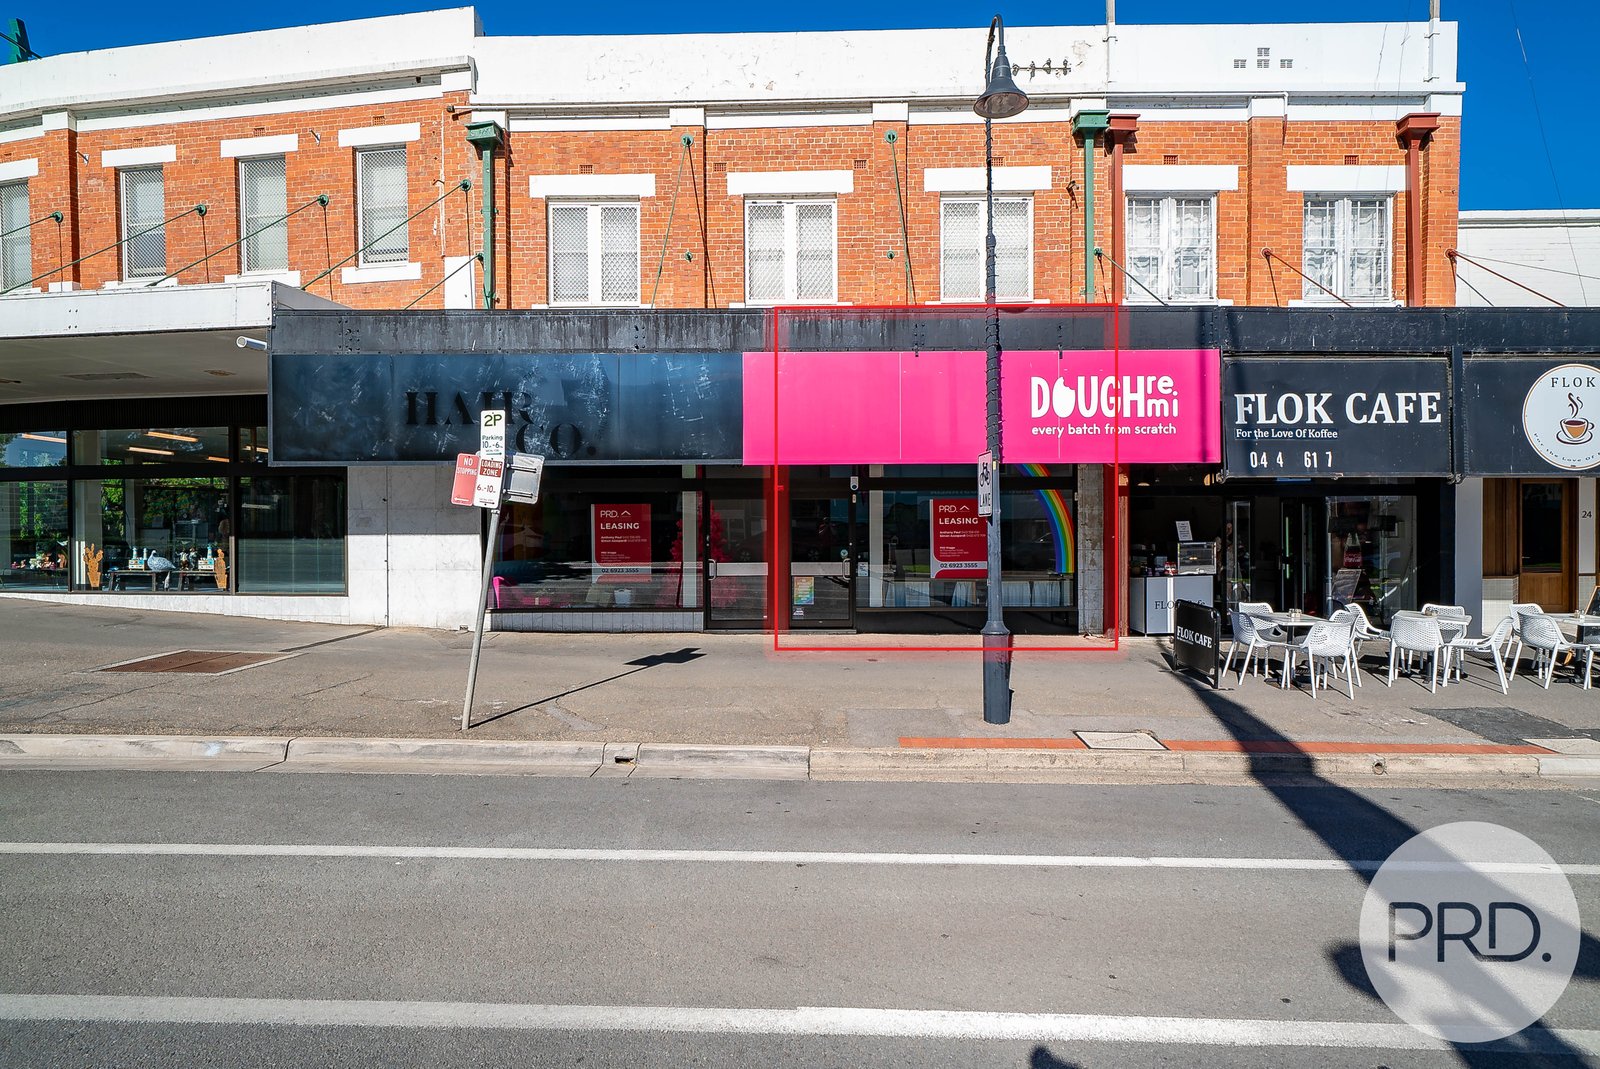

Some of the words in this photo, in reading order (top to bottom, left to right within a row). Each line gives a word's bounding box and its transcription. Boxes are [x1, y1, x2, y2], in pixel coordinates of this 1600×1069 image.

[1551, 377, 1596, 388] FLOK
[1031, 376, 1145, 418] DOUGH
[1234, 393, 1334, 424] FLOK
[1345, 392, 1442, 424] CAFE
[484, 414, 503, 427] 2P
[1031, 425, 1065, 438] every
[1068, 423, 1101, 435] batch
[1104, 423, 1131, 435] from
[1134, 422, 1177, 435] scratch
[1236, 429, 1252, 438] For
[1253, 429, 1270, 439] the
[1271, 429, 1294, 438] Love
[1295, 429, 1307, 438] Of
[1308, 429, 1338, 438] Koffee
[482, 434, 504, 442] Parking
[463, 457, 474, 466] NO
[481, 459, 503, 469] LOADING
[456, 466, 478, 476] STOPPING
[482, 467, 499, 477] ZONE
[1582, 510, 1592, 519] 24
[600, 522, 640, 530] LEASING
[938, 517, 979, 525] LEASING
[1154, 600, 1176, 610] FLO
[1177, 625, 1195, 642] FLOK
[1194, 632, 1213, 649] CAFE
